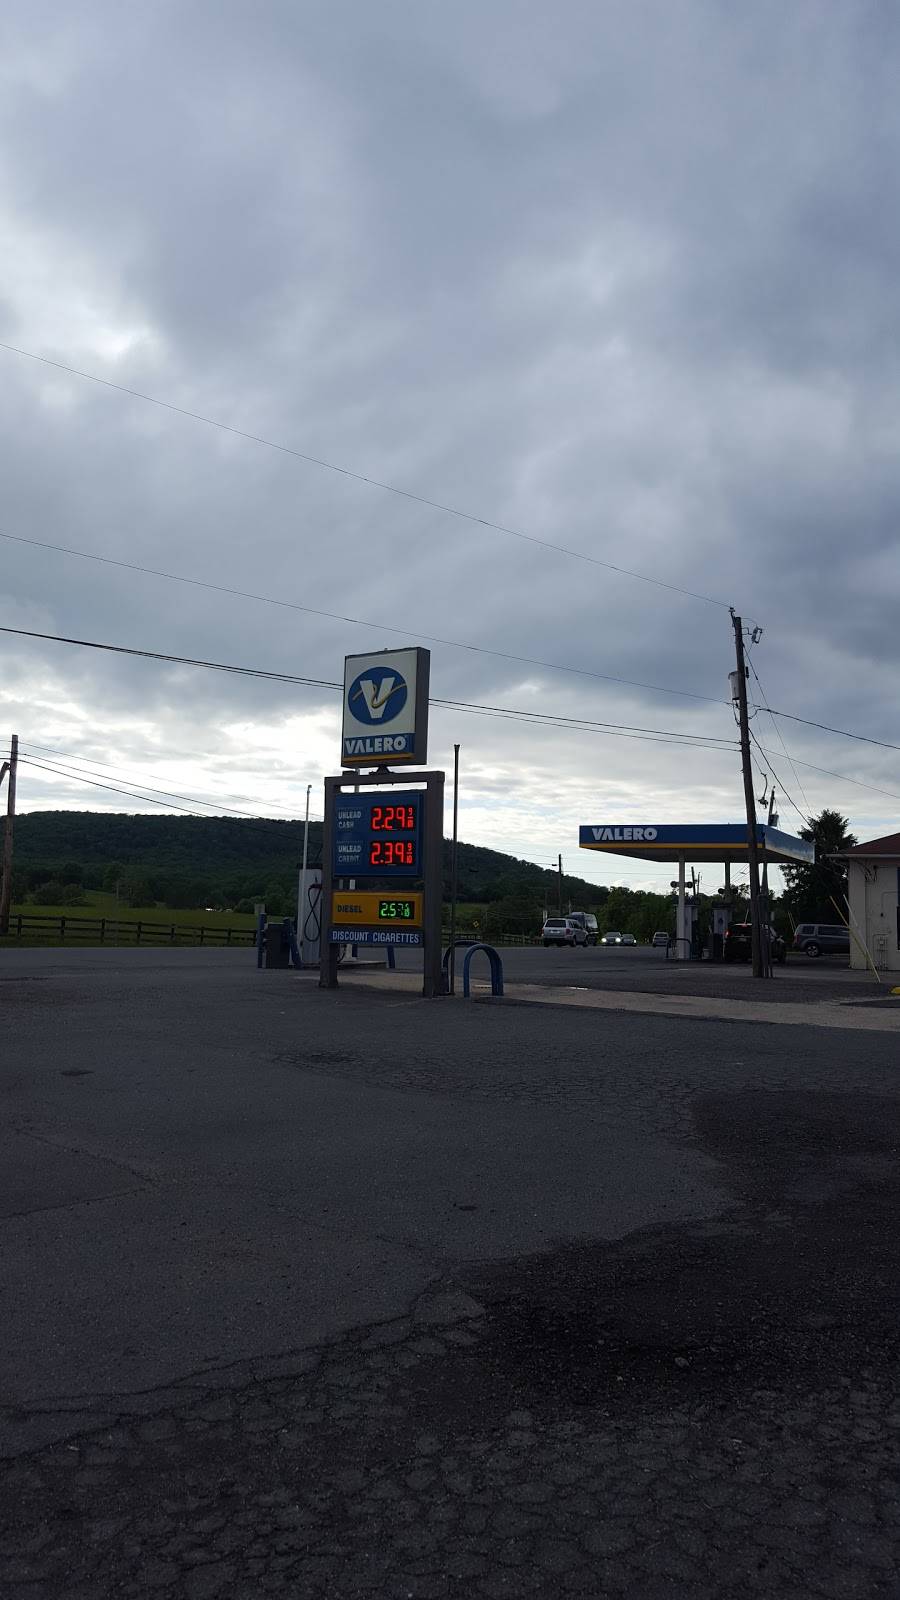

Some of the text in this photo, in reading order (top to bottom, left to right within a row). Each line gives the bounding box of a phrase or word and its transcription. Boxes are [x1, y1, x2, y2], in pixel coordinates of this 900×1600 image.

[345, 736, 406, 754] VALERO
[338, 811, 361, 819] UNLEAD
[372, 807, 405, 829] 2.29
[592, 827, 657, 841] VALERO
[338, 845, 361, 853] UNLEAD
[371, 843, 404, 864] 2.39
[337, 904, 362, 913] DIESEL
[332, 931, 420, 943] DISCOUNT CIGARETTES
